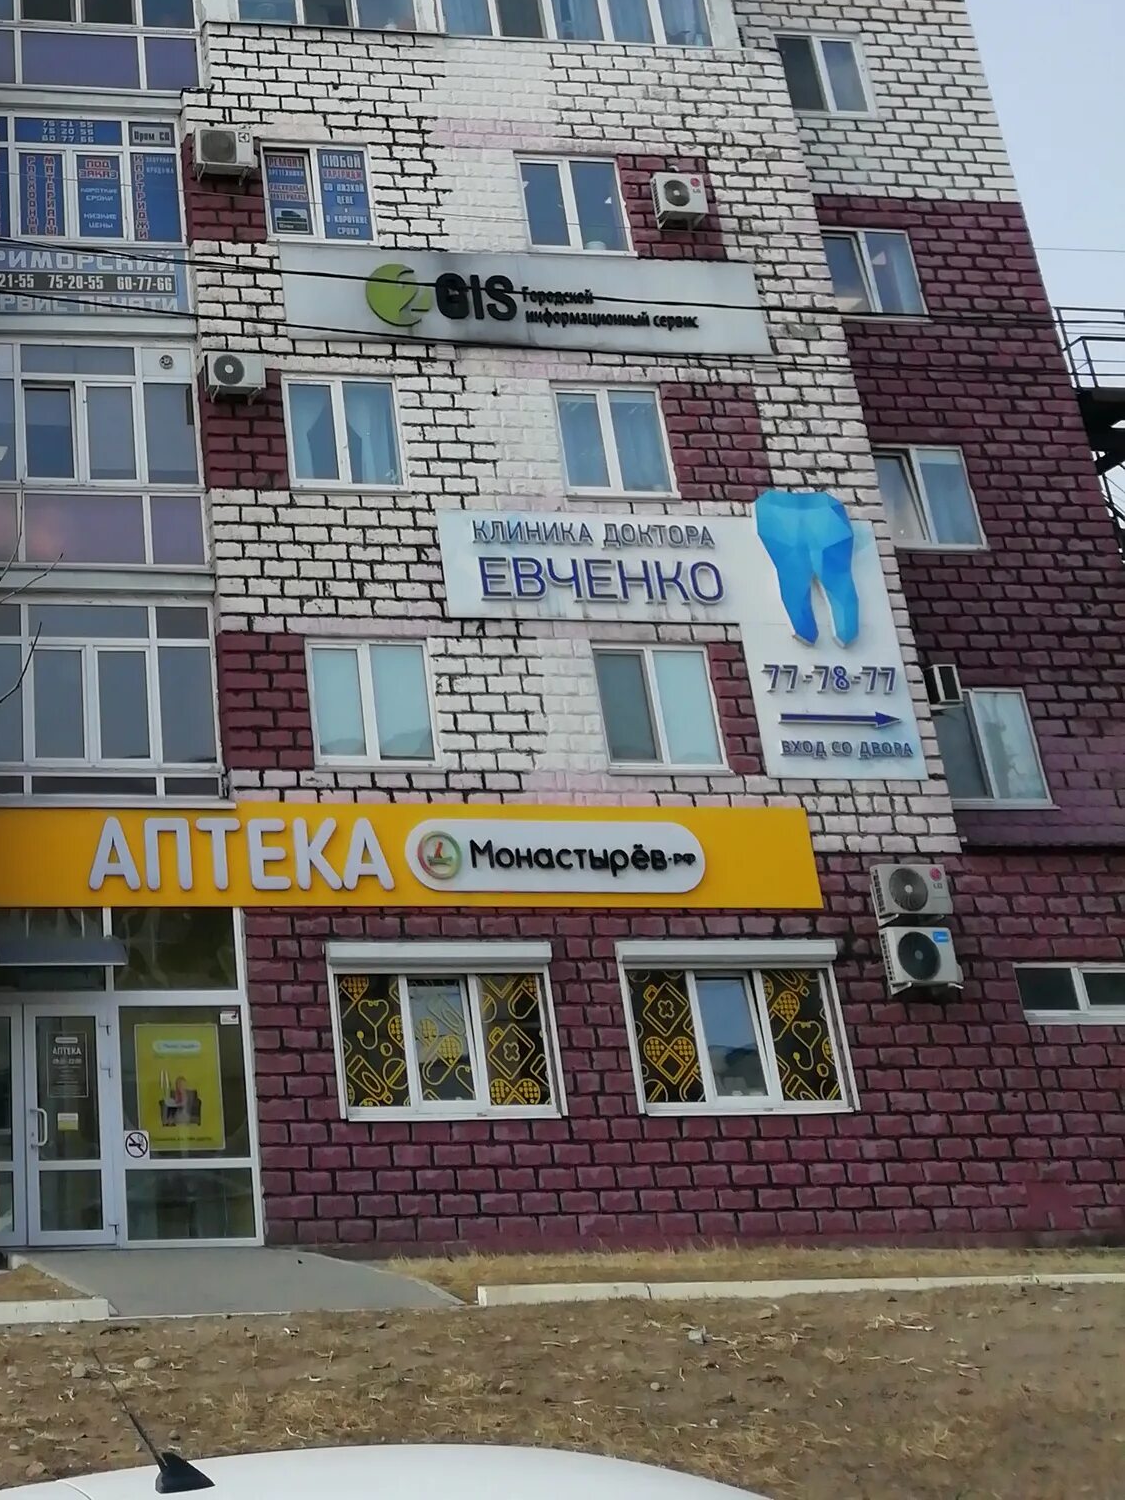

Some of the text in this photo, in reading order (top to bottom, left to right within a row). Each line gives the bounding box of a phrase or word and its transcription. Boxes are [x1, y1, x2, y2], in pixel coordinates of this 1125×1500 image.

[79, 169, 118, 179] ЗАКАЗ
[85, 159, 111, 169] ПОД
[321, 154, 362, 168] ЛЮБОЙ
[27, 156, 38, 235] РАСХОДНЫЕ
[44, 155, 58, 236] МАТЕРИАЛЫ
[133, 154, 150, 239] КАРТРИДЖИ
[48, 274, 104, 290] 75-20-55
[116, 276, 173, 291] 60-77-66
[525, 308, 700, 331] информационный сервис
[473, 519, 716, 549] КЛИНИКА ДОКТОРА
[478, 555, 725, 604] ЕВЧЕНКО
[761, 663, 897, 695] 77-78-77
[780, 739, 914, 758] ВХОД СО ДВОРА
[87, 816, 395, 891] АПТЕКА
